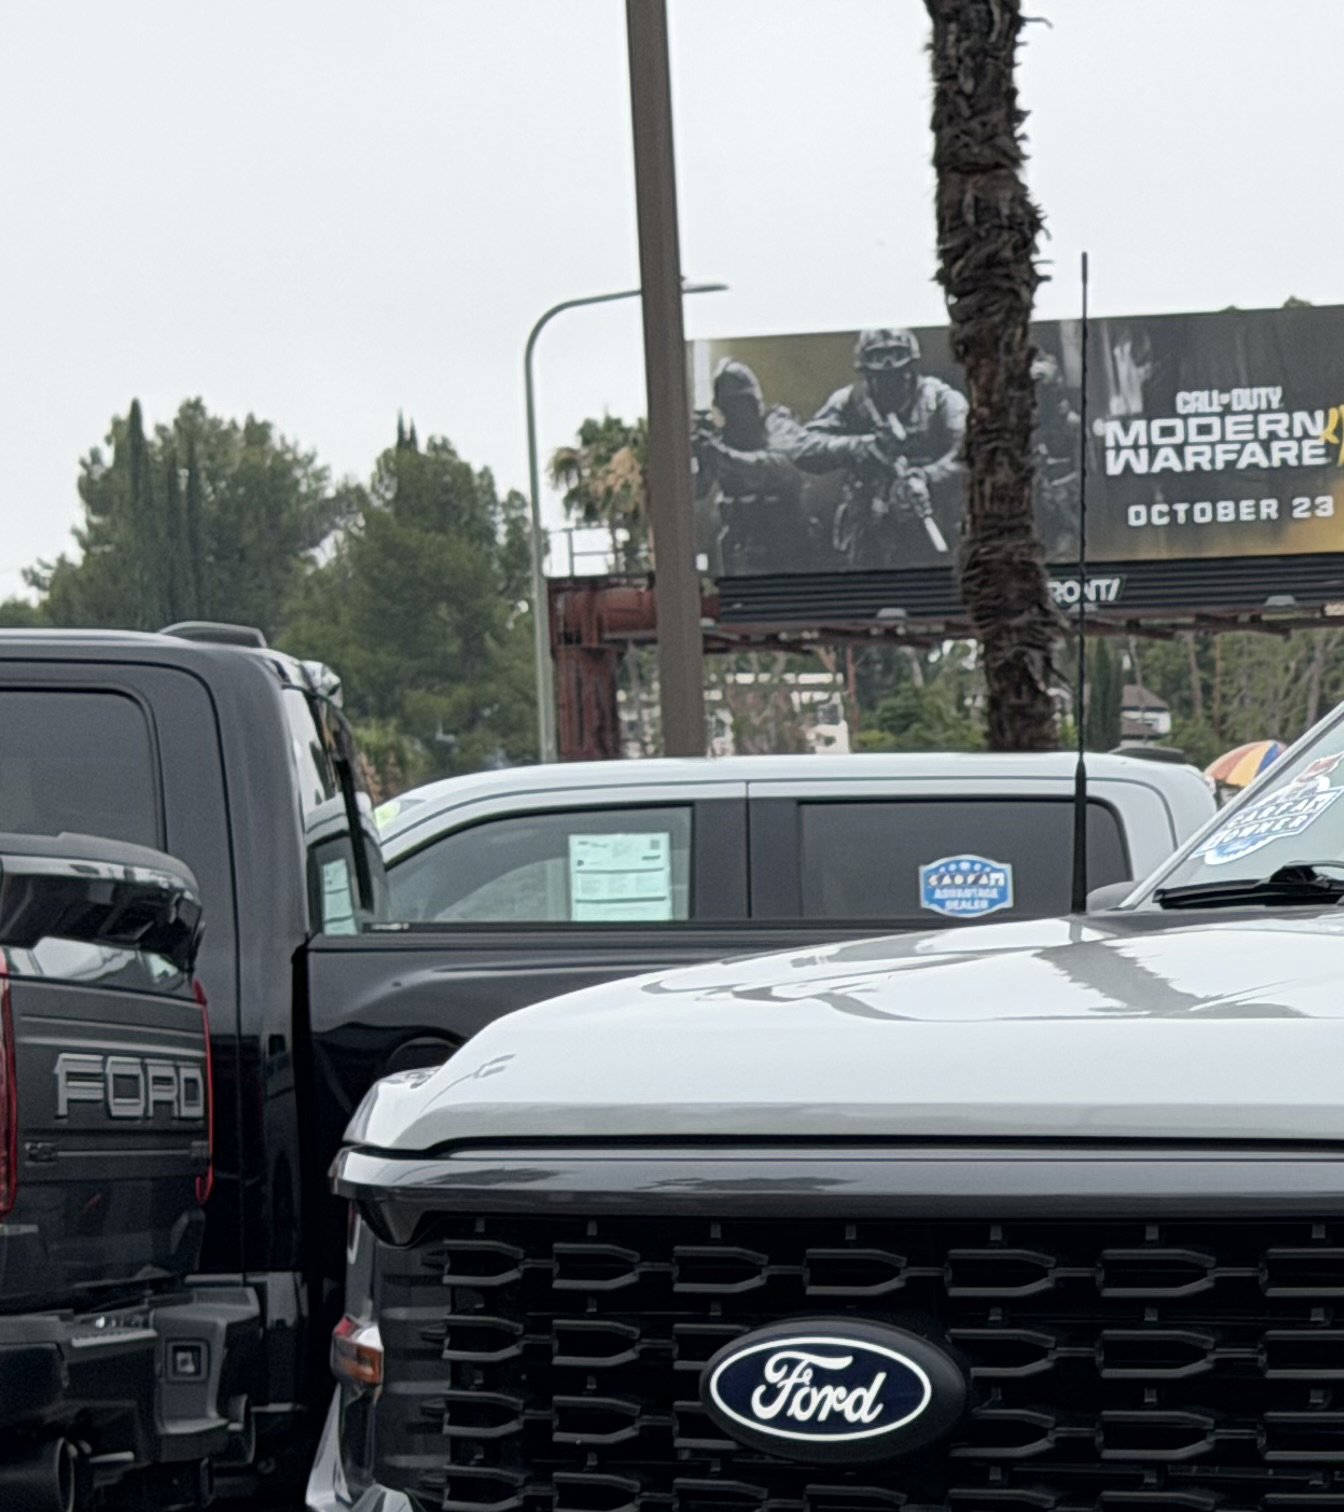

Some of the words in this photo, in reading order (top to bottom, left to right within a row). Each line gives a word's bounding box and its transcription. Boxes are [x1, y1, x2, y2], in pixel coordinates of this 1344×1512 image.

[1231, 385, 1283, 412] DUTY
[1104, 408, 1325, 448] MODERN
[1104, 438, 1329, 476] WARFARE
[1127, 497, 1280, 528] OCTOBER
[1291, 494, 1335, 519] 23
[53, 1052, 205, 1120] FORD
[750, 1350, 888, 1424] Ford
